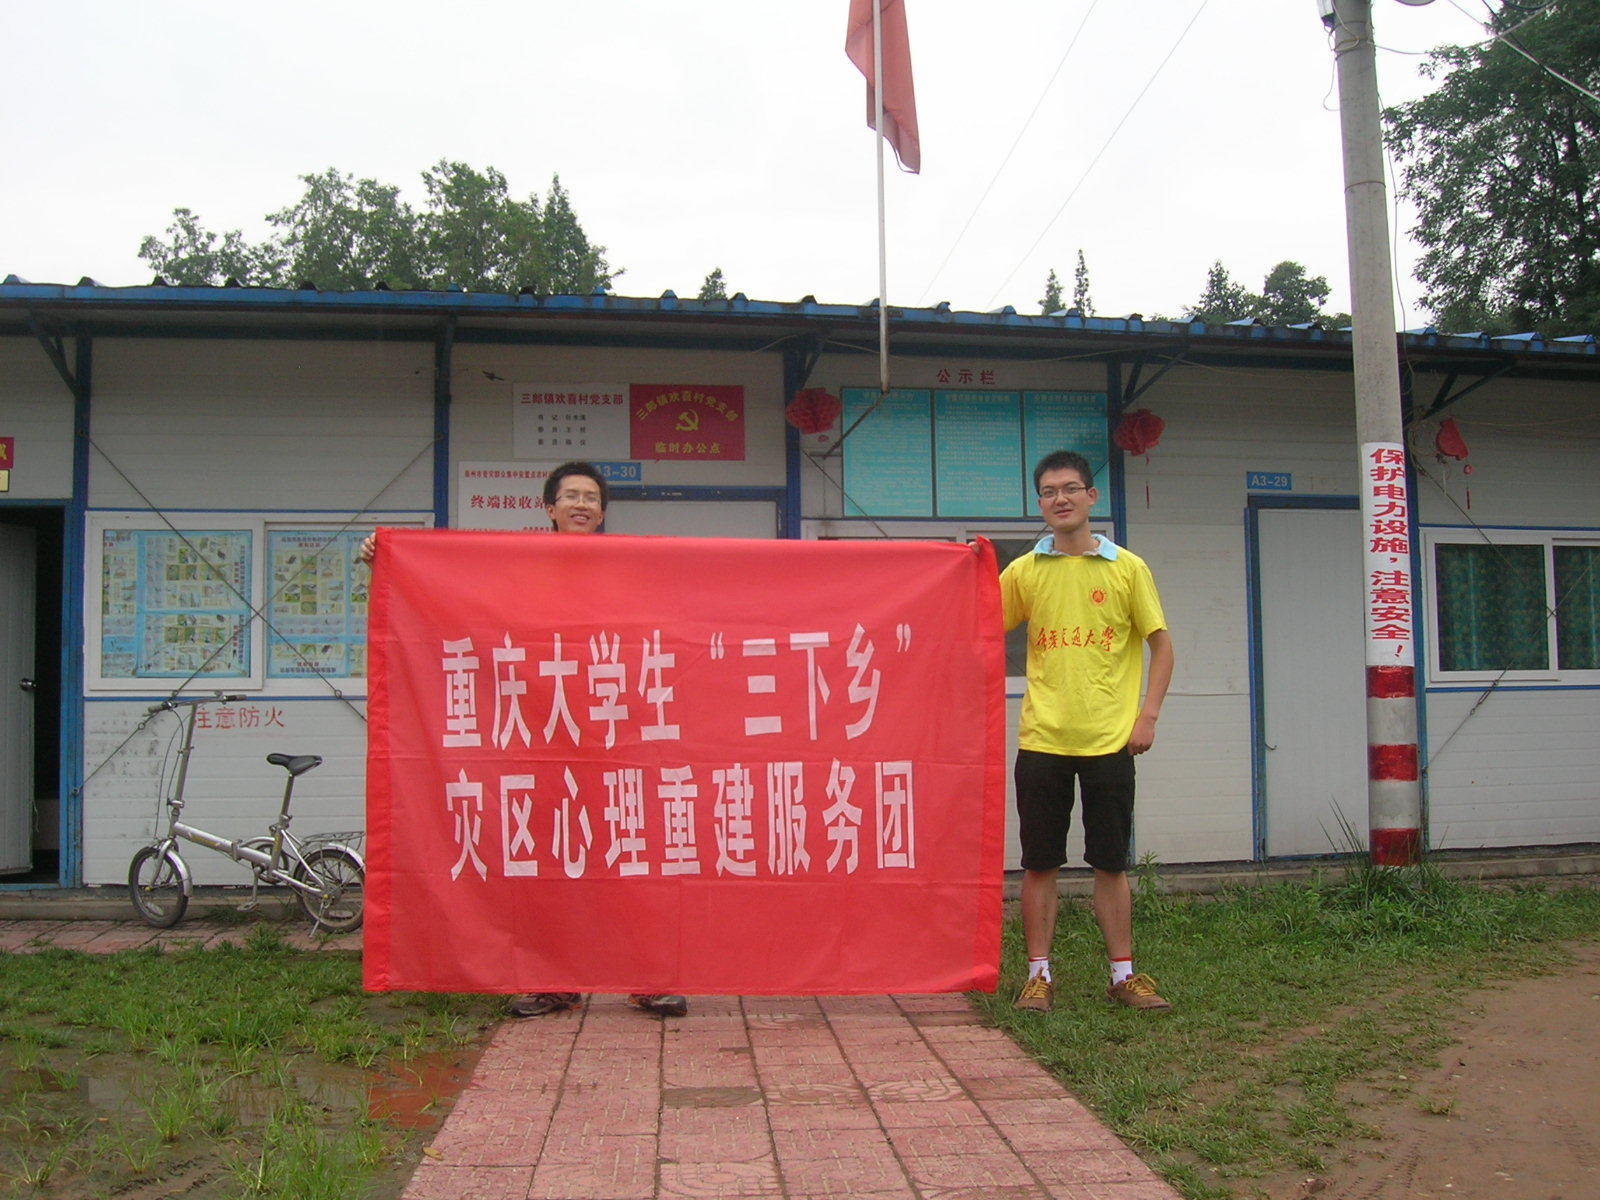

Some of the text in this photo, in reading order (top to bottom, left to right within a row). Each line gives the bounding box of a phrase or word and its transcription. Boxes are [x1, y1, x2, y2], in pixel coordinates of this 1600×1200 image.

[936, 368, 997, 386] 公示栏
[520, 393, 624, 405] 三郎镇欢喜村党支部
[655, 441, 721, 454] 临时办公点
[1251, 475, 1288, 488] A3-29
[446, 757, 917, 883] 灾区心理重建服务团
